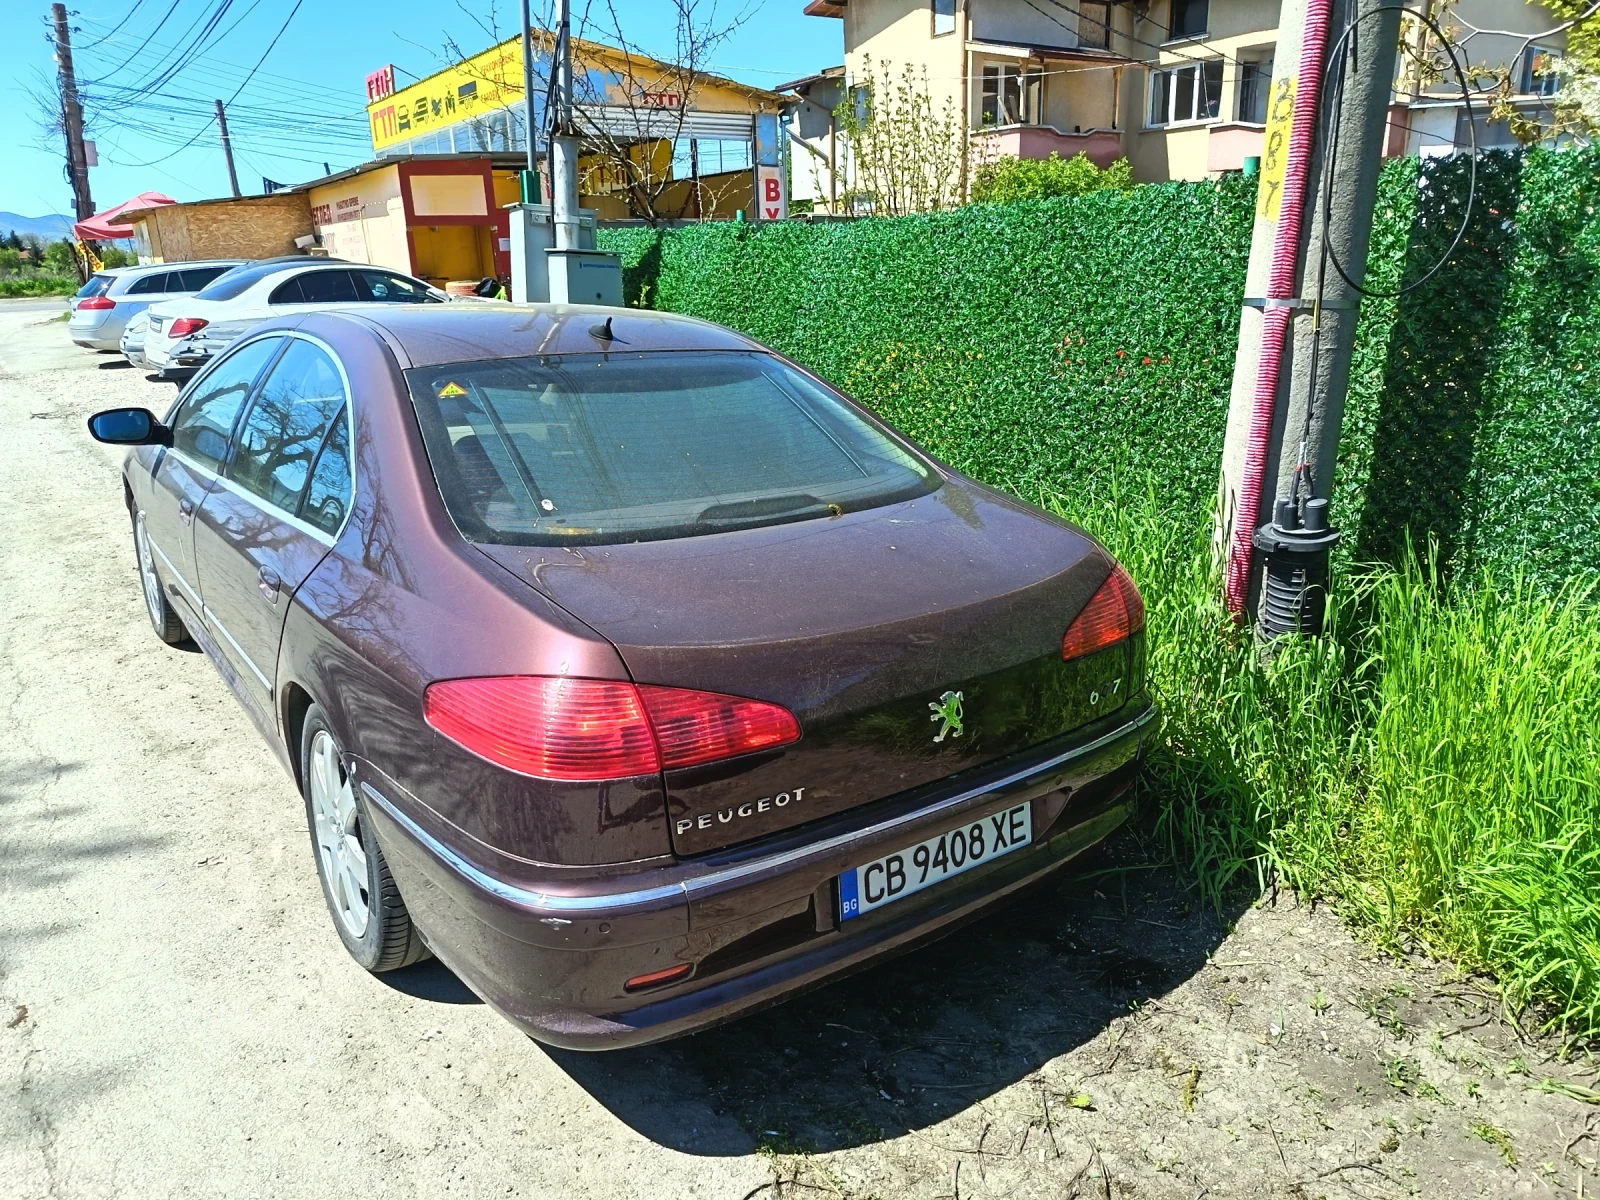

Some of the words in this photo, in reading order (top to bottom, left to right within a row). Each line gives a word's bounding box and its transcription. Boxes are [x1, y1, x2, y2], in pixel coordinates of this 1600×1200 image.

[643, 92, 681, 107] ГТП
[373, 105, 398, 142] ГТП
[1090, 678, 1121, 705] 607
[676, 787, 805, 835] PEUGEOT
[864, 855, 906, 904] CB
[913, 823, 985, 884] 9408
[992, 806, 1026, 853] XE
[843, 898, 857, 914] BG
